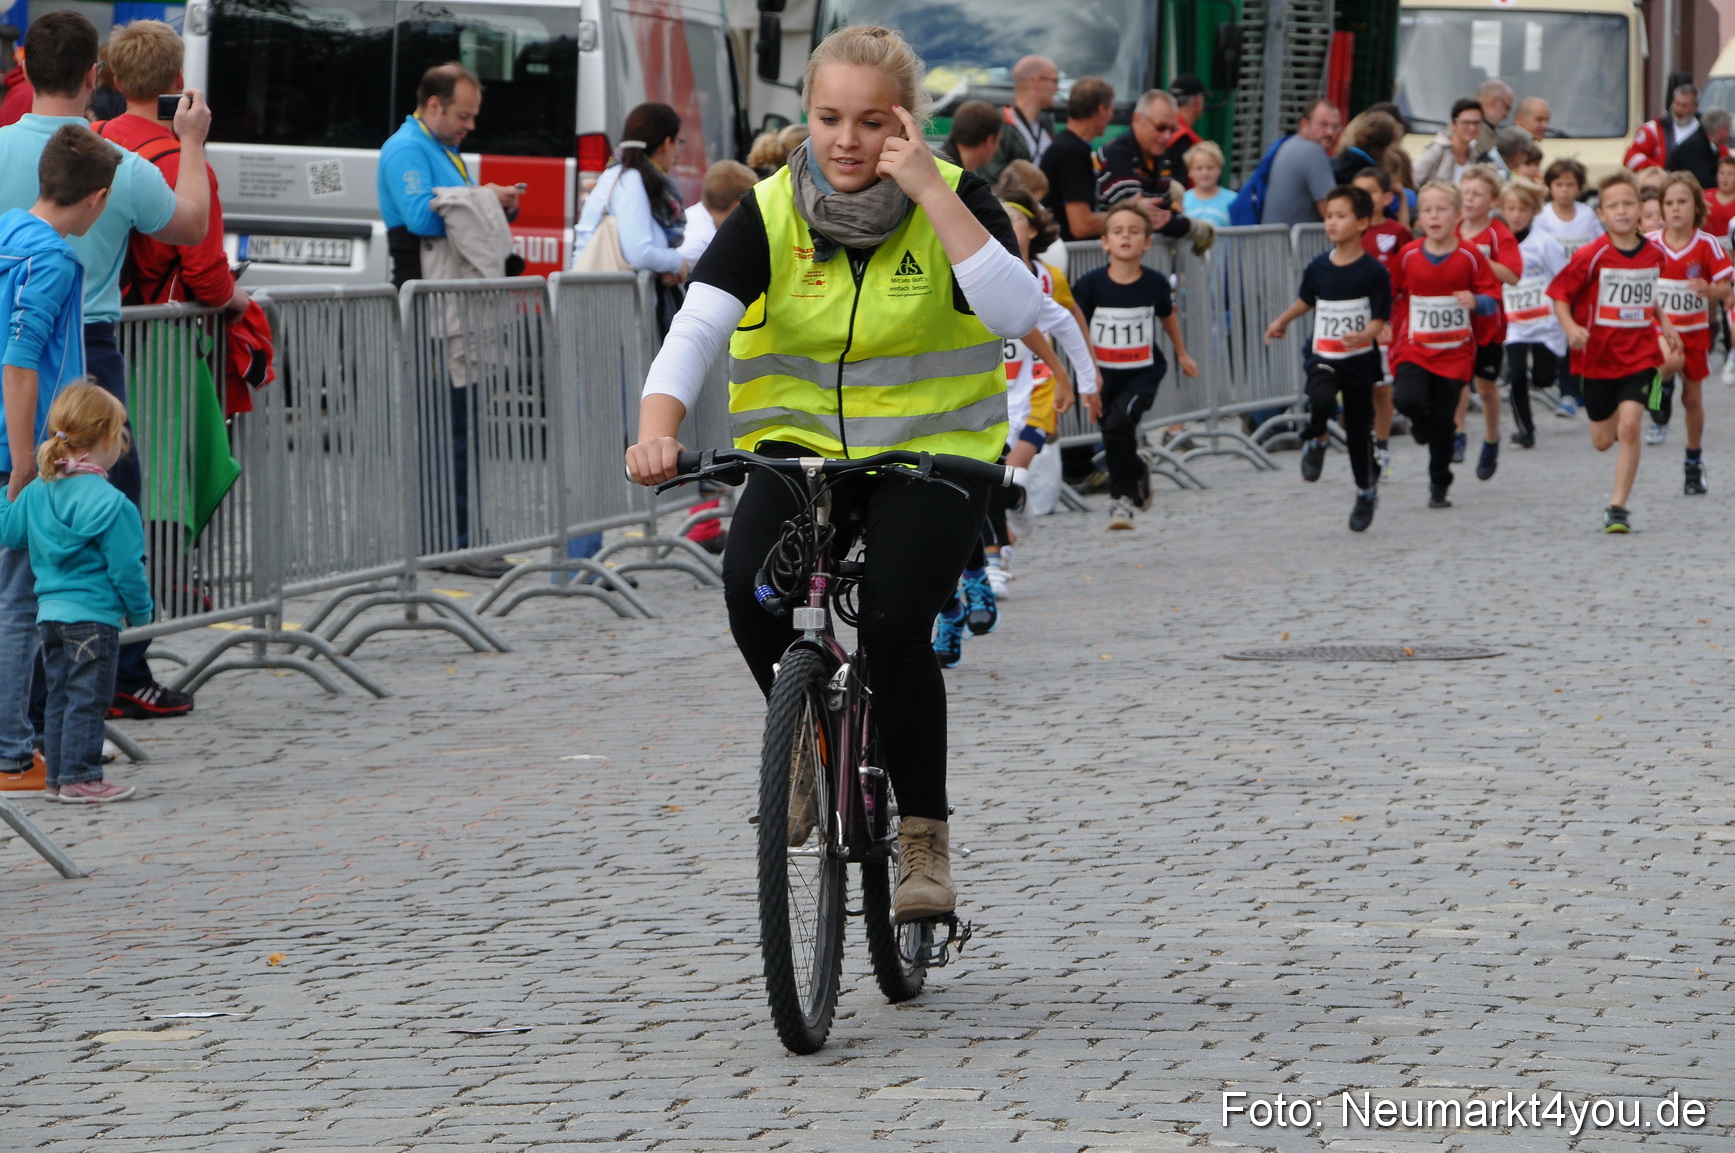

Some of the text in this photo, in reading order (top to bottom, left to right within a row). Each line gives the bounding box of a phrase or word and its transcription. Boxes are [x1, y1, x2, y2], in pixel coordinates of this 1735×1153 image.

[308, 241, 348, 259] 1111
[512, 235, 558, 264] aun
[1608, 282, 1653, 304] 7099
[1321, 314, 1366, 338] 7238
[1417, 308, 1464, 329] 7093
[1096, 322, 1143, 345] 7111
